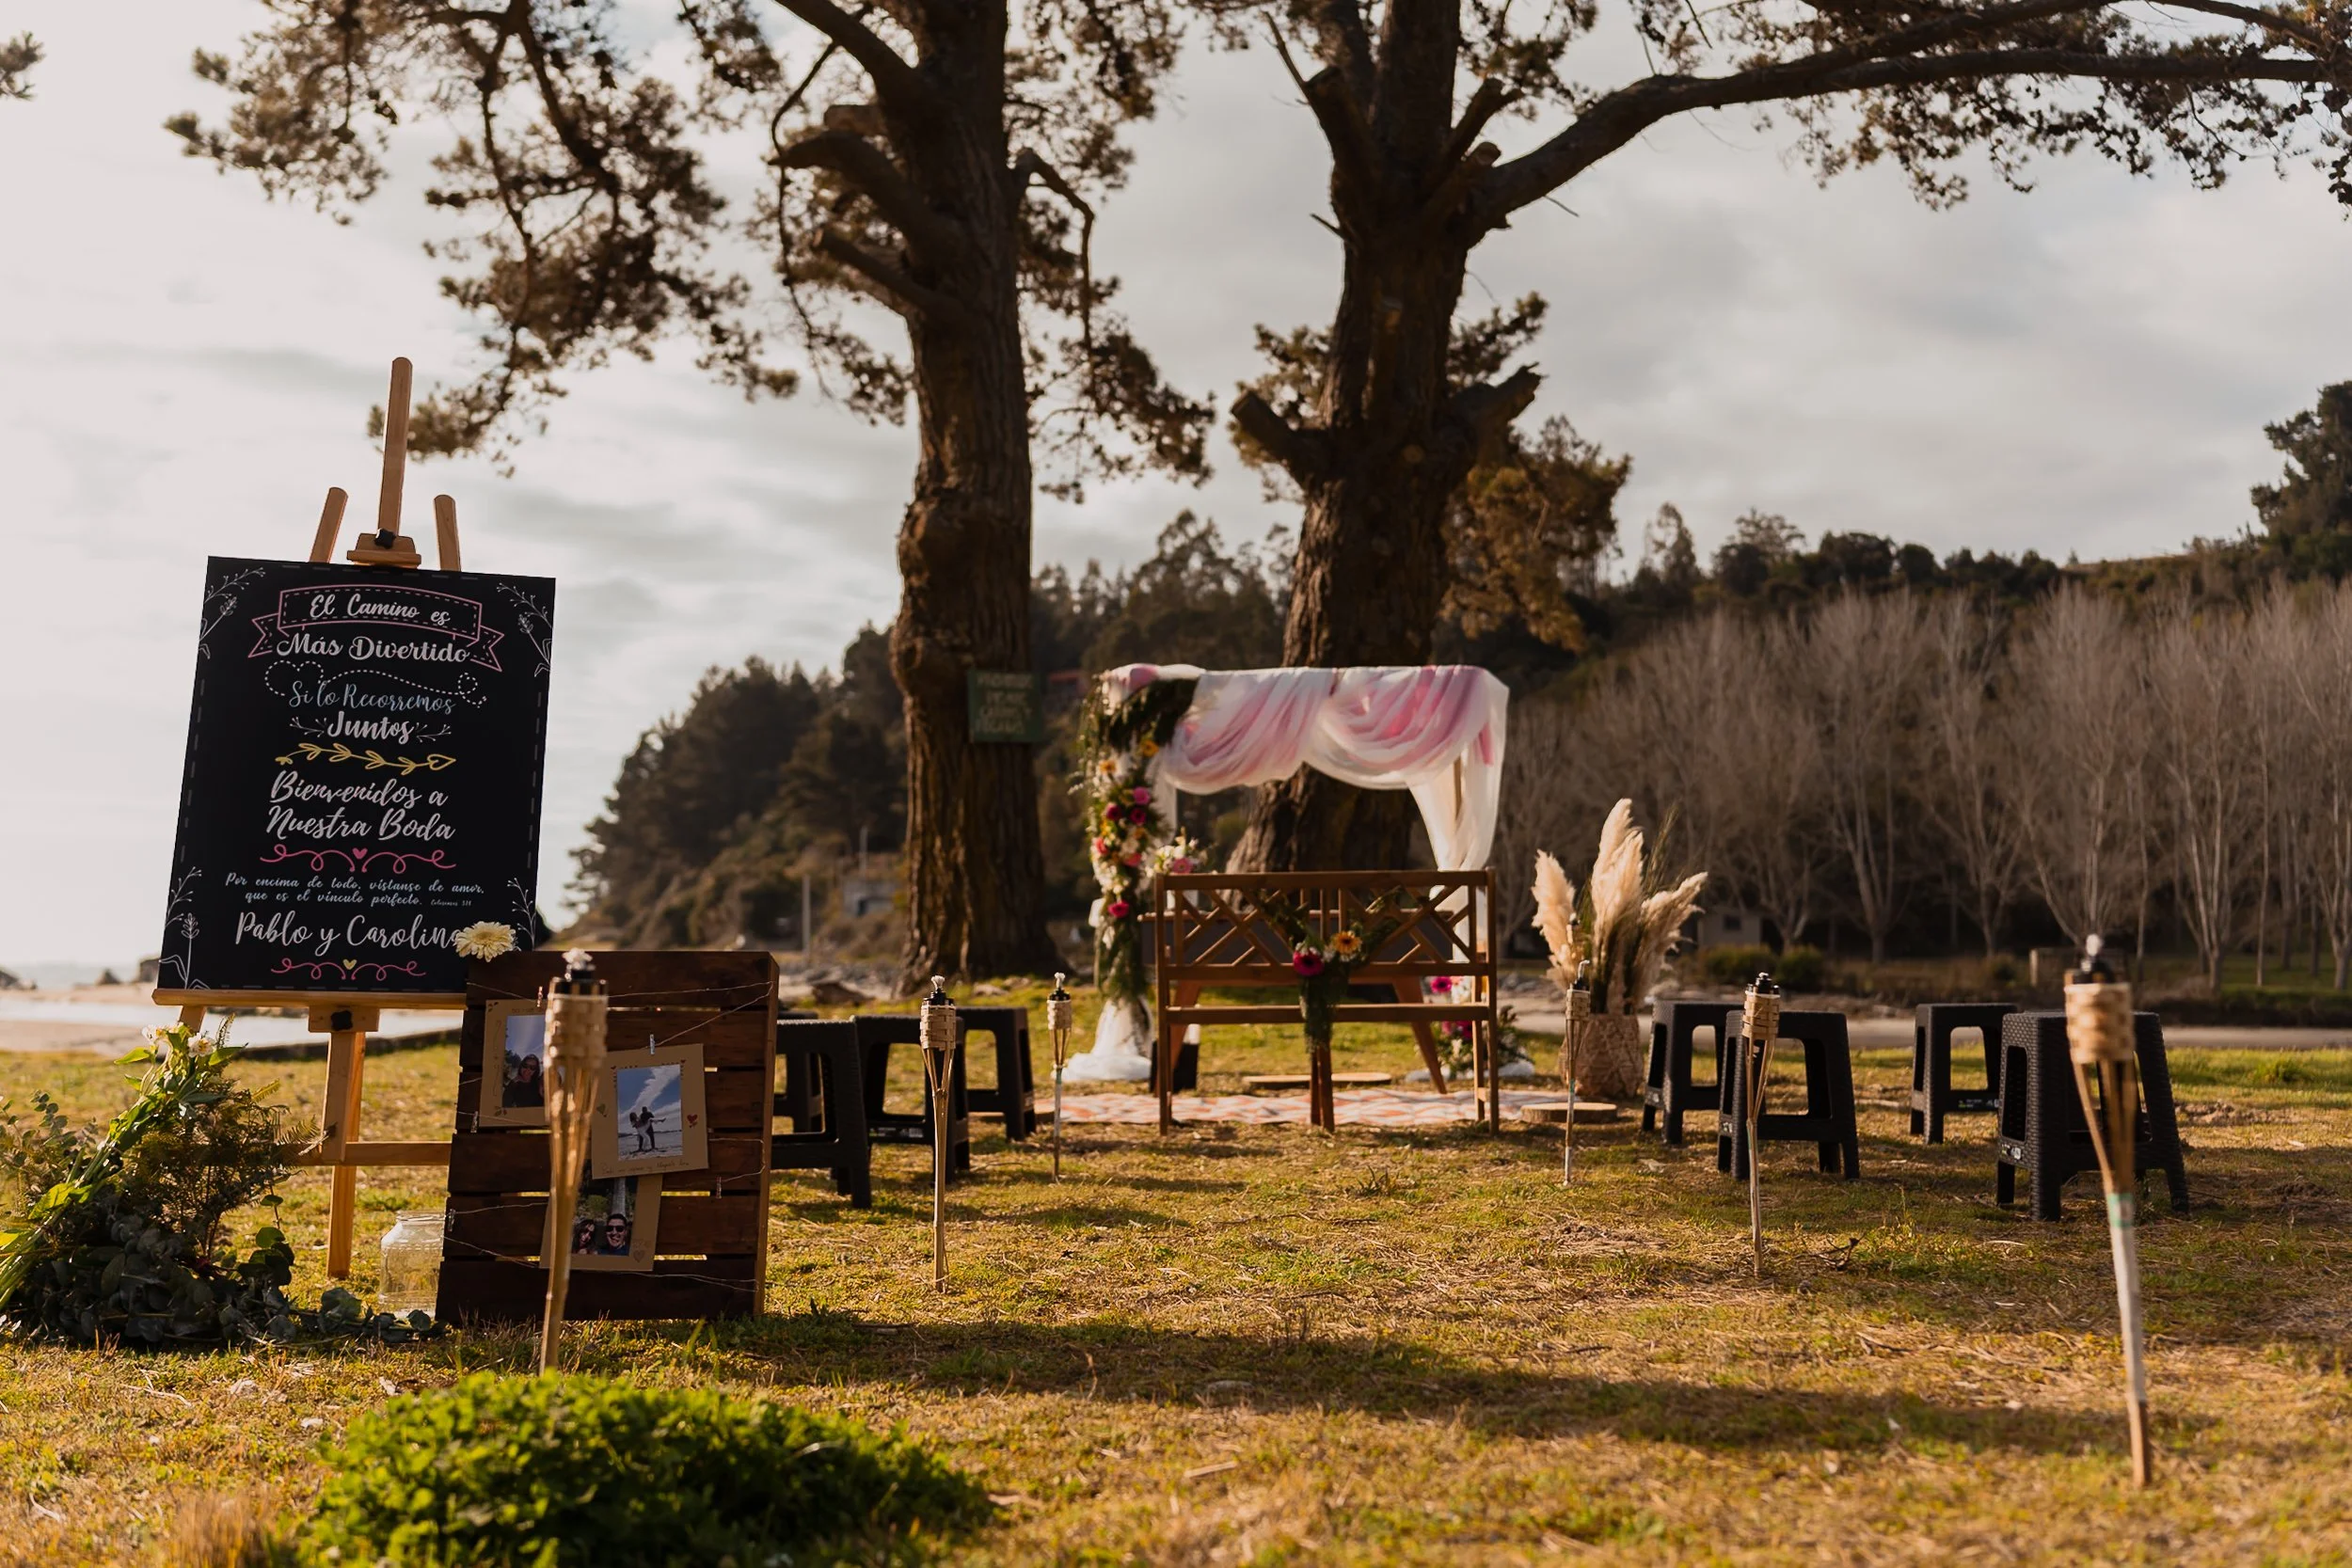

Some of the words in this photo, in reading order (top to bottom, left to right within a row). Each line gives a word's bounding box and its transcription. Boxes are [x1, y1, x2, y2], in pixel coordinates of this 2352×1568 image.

[310, 594, 335, 618] El
[347, 594, 420, 619] Camino
[430, 610, 451, 626] es
[277, 632, 343, 657] Más
[348, 636, 469, 663] Divertido
[289, 680, 313, 707] Si
[316, 681, 340, 706] lo
[343, 683, 455, 715] Recorremos
[327, 711, 415, 745] Juntos
[270, 770, 421, 809] Bienvenidos
[428, 790, 449, 806] a
[265, 805, 373, 840] Nuestra
[378, 807, 455, 841] Boda
[225, 872, 247, 886] Por
[255, 878, 299, 887] encima
[307, 875, 324, 887] de
[428, 879, 444, 892] de
[245, 892, 268, 903] que
[276, 892, 289, 902] es
[296, 888, 311, 901] el
[235, 911, 312, 947] Pablo
[315, 927, 341, 957] y
